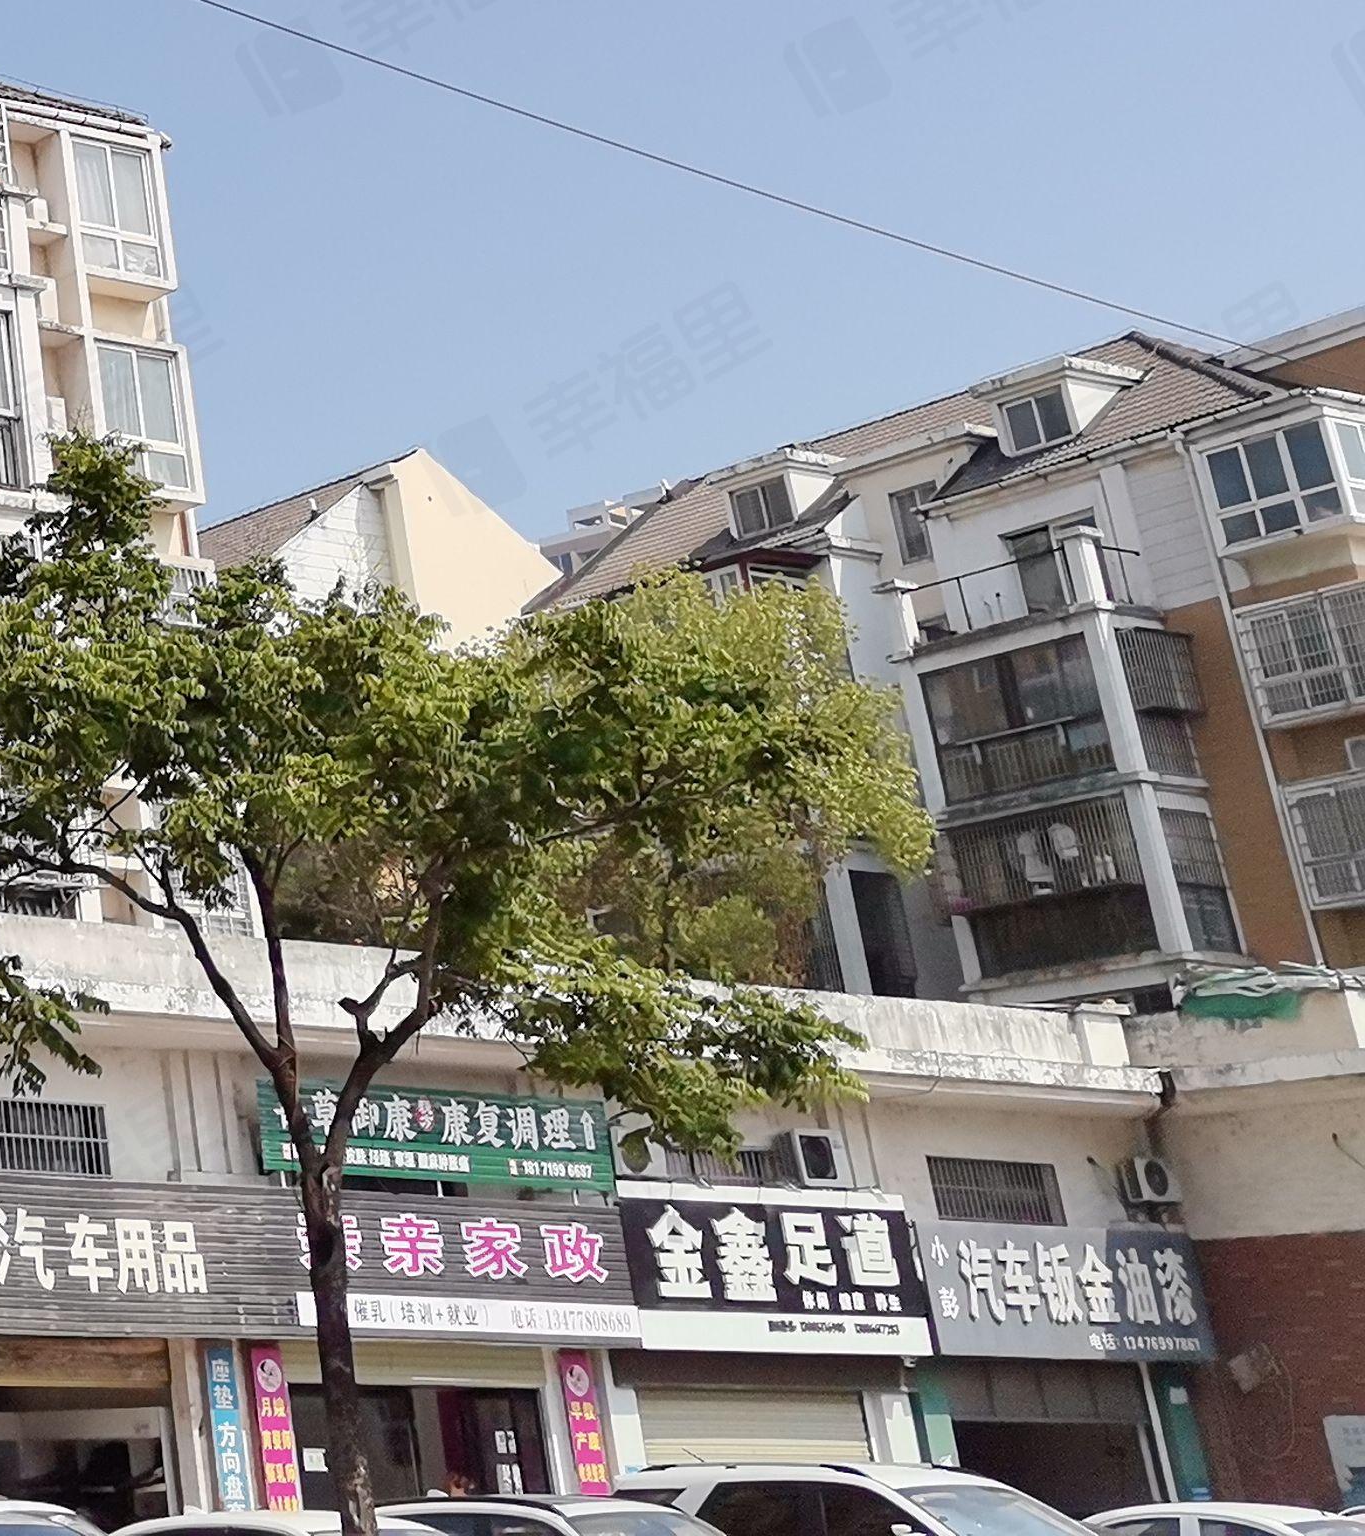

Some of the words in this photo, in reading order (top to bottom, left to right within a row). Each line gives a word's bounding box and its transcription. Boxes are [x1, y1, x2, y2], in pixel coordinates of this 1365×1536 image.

[440, 1097, 577, 1151] 康复调理
[645, 1204, 901, 1302] 金鑫足道
[930, 1235, 960, 1320] 小彭
[957, 1239, 1197, 1326] 汽车钣金油漆
